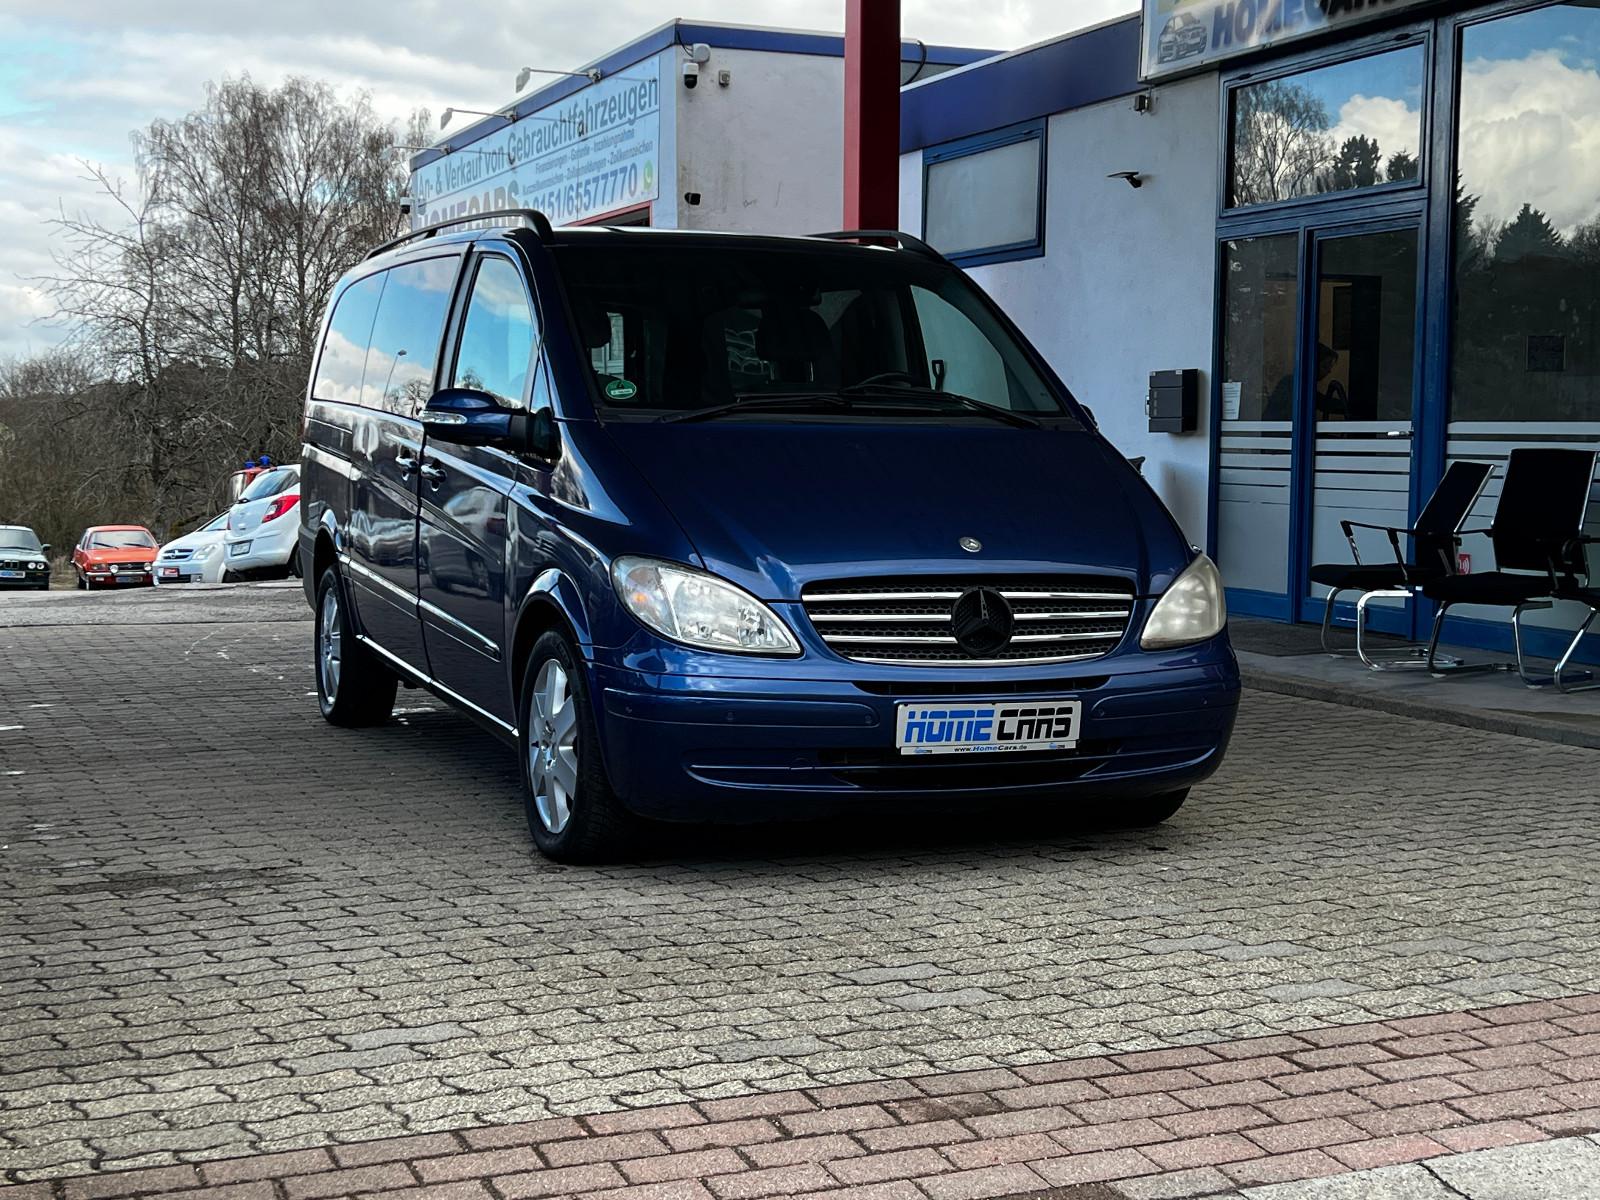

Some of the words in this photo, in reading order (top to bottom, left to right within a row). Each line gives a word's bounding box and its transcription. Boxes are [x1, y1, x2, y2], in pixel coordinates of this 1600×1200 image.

[435, 166, 442, 195] &
[445, 147, 482, 191] Verkauf
[484, 145, 504, 175] von
[507, 78, 658, 165] Gebrauchtfahrzeugen
[904, 709, 995, 743] HOME
[997, 706, 1073, 741] CARS
[954, 744, 1028, 752] www.HomeCars.de
